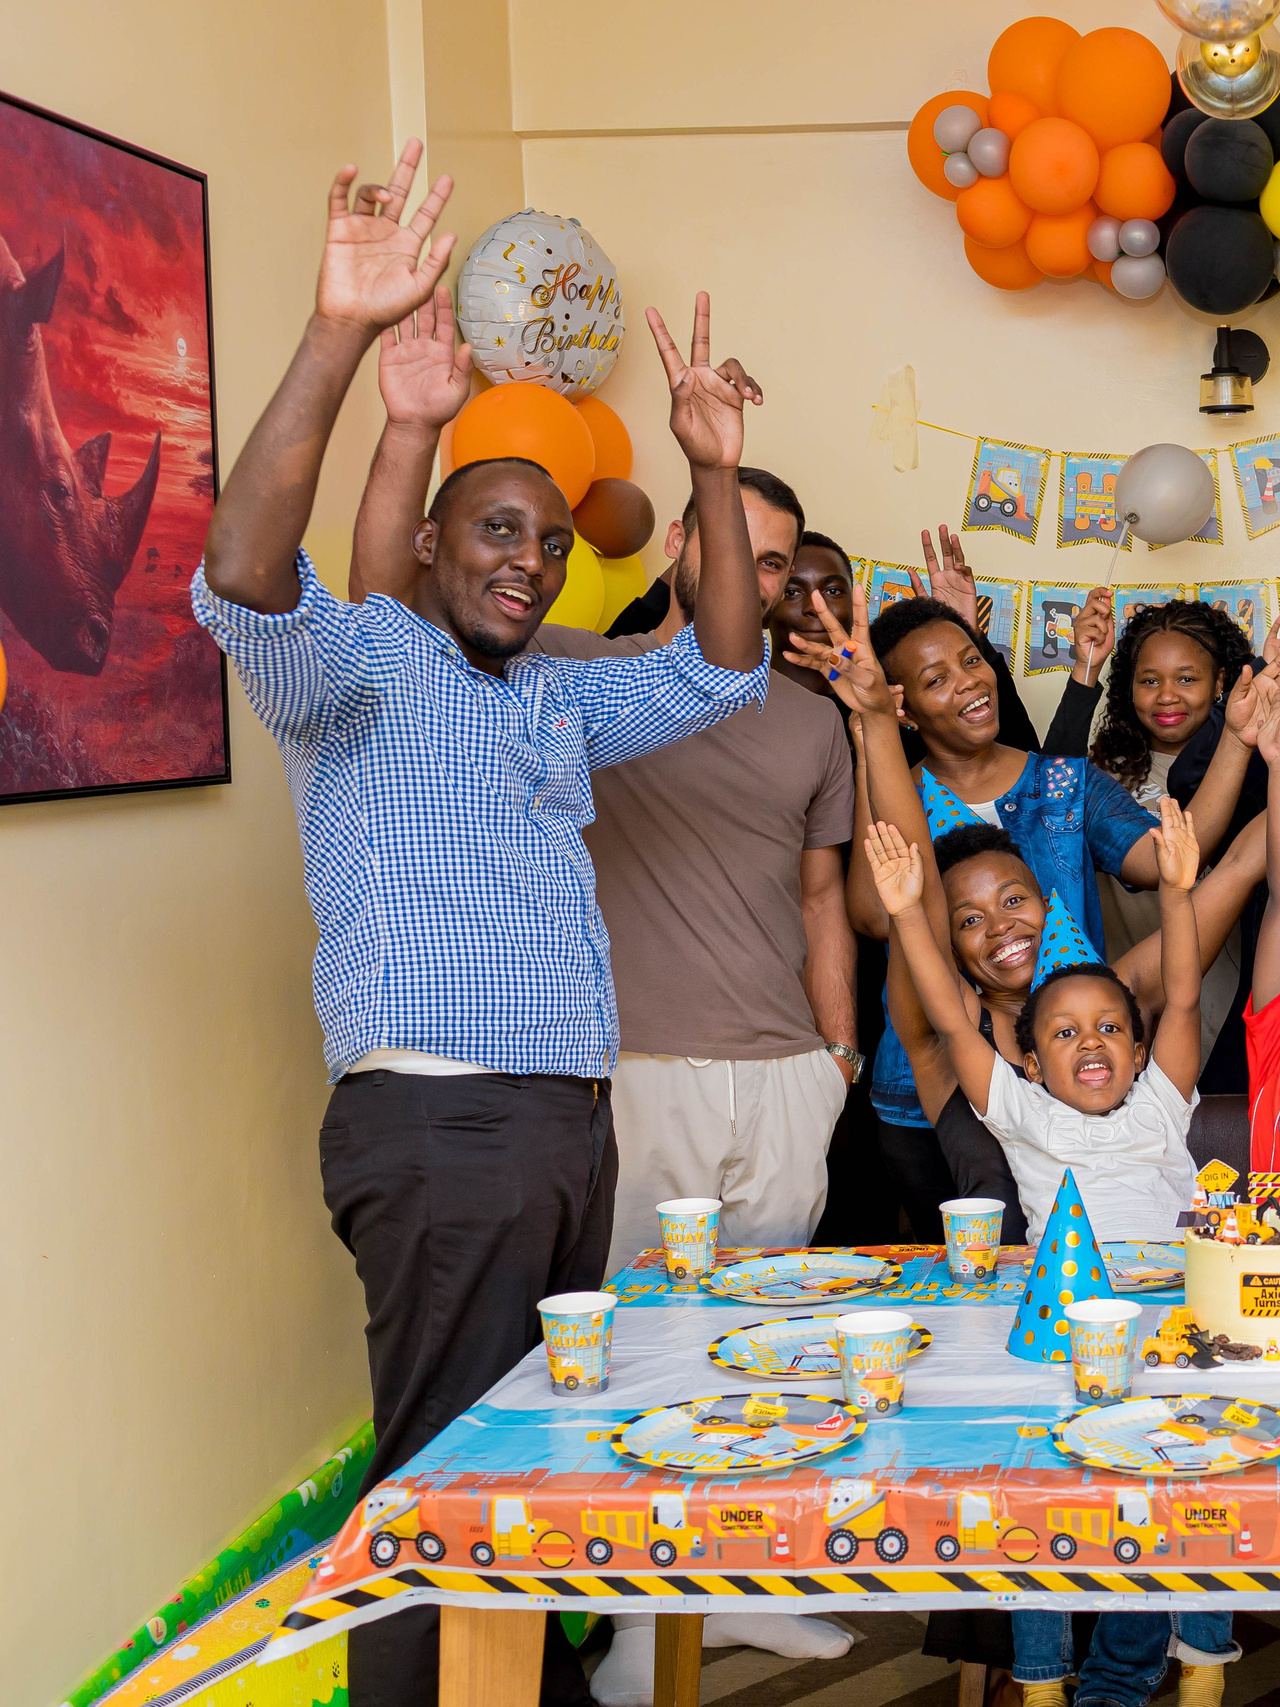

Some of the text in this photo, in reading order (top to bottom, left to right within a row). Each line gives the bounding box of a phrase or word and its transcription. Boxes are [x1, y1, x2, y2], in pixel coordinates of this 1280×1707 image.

[531, 263, 622, 317] Happy
[521, 315, 619, 355] Birthda
[1204, 1172, 1229, 1182] DIG IN
[971, 1217, 1002, 1231] HAPP
[661, 1232, 703, 1243] HDAY
[955, 1228, 1001, 1243] BIRTH
[543, 1319, 580, 1335] APPY
[544, 1333, 599, 1348] THDAY
[1070, 1327, 1105, 1343] APPY
[872, 1336, 910, 1355] HAPP
[1071, 1340, 1124, 1356] THDAY
[851, 1350, 908, 1370] BIRTH
[720, 1510, 763, 1522] UNDER
[1185, 1508, 1227, 1520] UNDER
